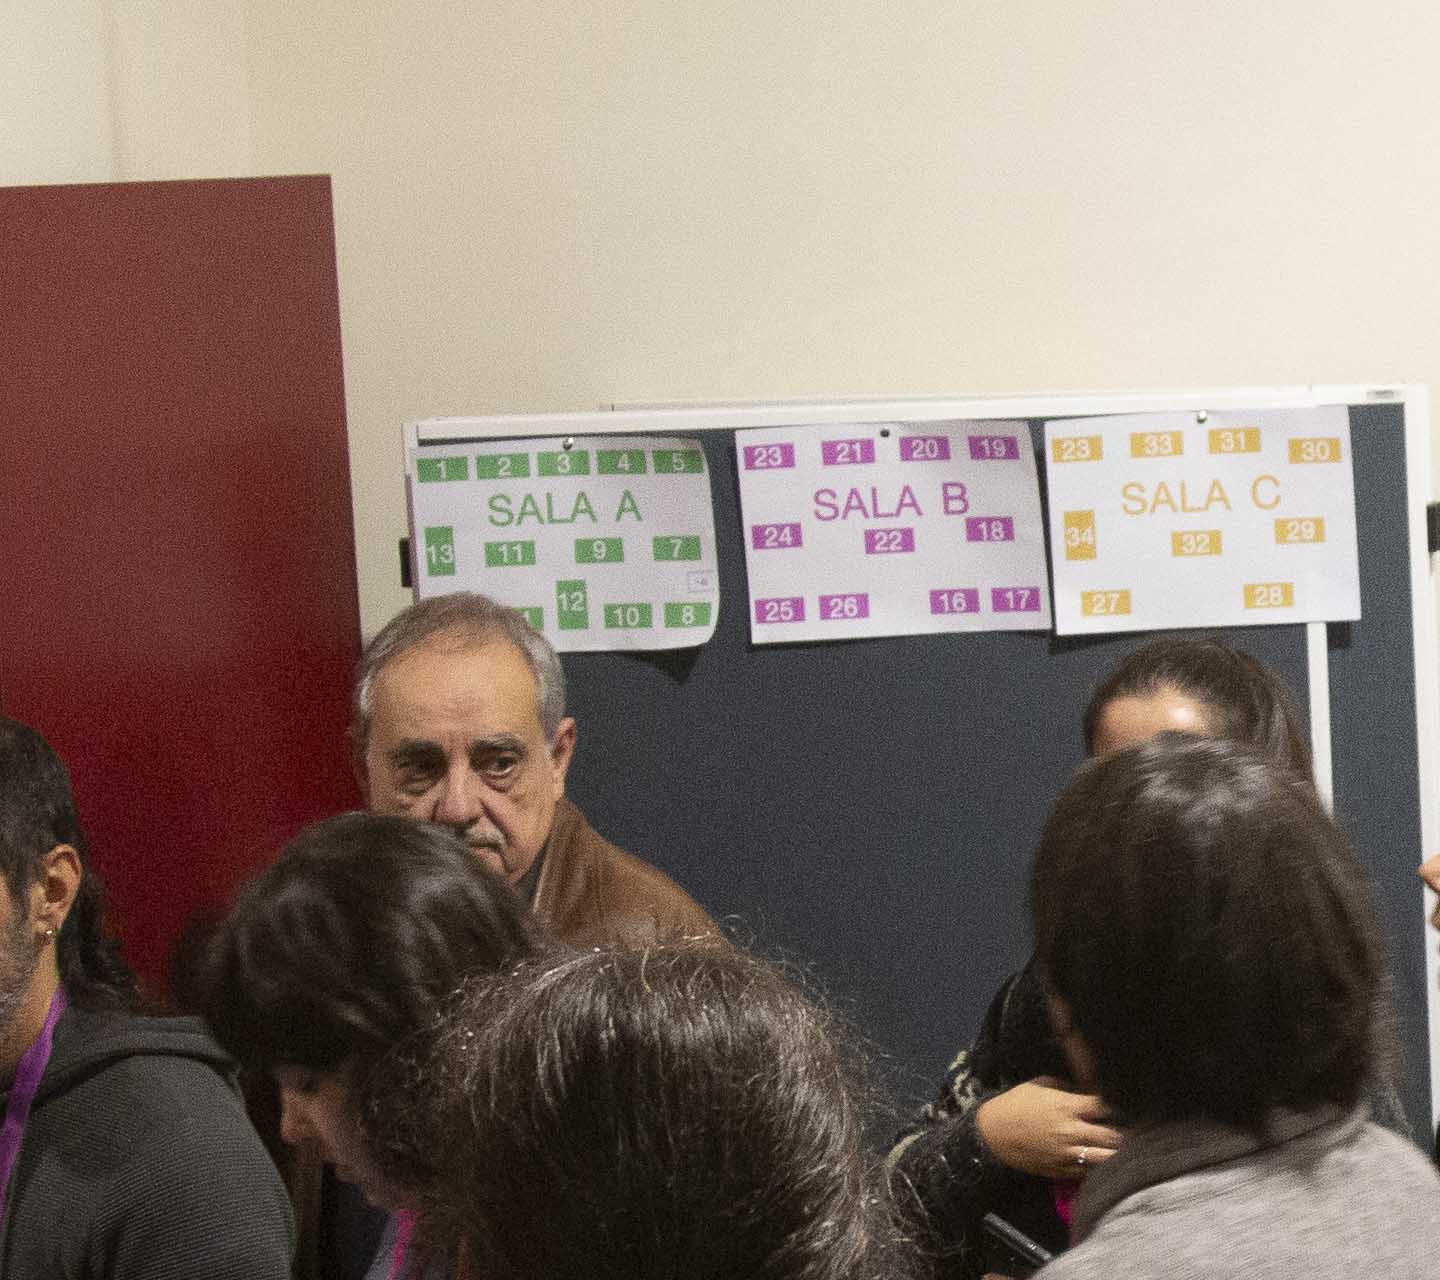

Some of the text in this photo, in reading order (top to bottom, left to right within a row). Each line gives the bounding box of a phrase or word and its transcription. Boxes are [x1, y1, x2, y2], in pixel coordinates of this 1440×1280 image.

[911, 439, 937, 458] 20
[981, 438, 1006, 457] 19
[1061, 440, 1089, 459] 23
[1145, 435, 1173, 455] 33
[1221, 432, 1246, 451] 31
[754, 447, 783, 466] 23
[836, 443, 861, 461] 21
[1301, 442, 1329, 461] 30
[437, 461, 447, 479] 1
[498, 458, 510, 477] 2
[558, 455, 571, 472] 3
[617, 454, 630, 471] 4
[672, 453, 685, 471] 5
[814, 482, 970, 521] SALA B
[1121, 474, 1282, 516] SALA C
[487, 489, 644, 527] SALA A
[764, 527, 793, 546] 24
[978, 521, 1003, 539] 18
[1067, 527, 1094, 545] 34
[1287, 522, 1316, 541] 29
[592, 541, 606, 560] 9
[671, 539, 682, 558] 7
[874, 532, 903, 551] 22
[1182, 534, 1210, 553] 32
[427, 545, 454, 564] 13
[498, 545, 524, 563] 11
[559, 592, 584, 611] 12
[940, 593, 965, 612] 16
[1007, 591, 1030, 610] 17
[1092, 593, 1121, 613] 27
[1254, 586, 1283, 606] 28
[614, 608, 639, 626] 10
[682, 606, 695, 625] 8
[765, 601, 793, 620] 25
[830, 598, 858, 617] 26
